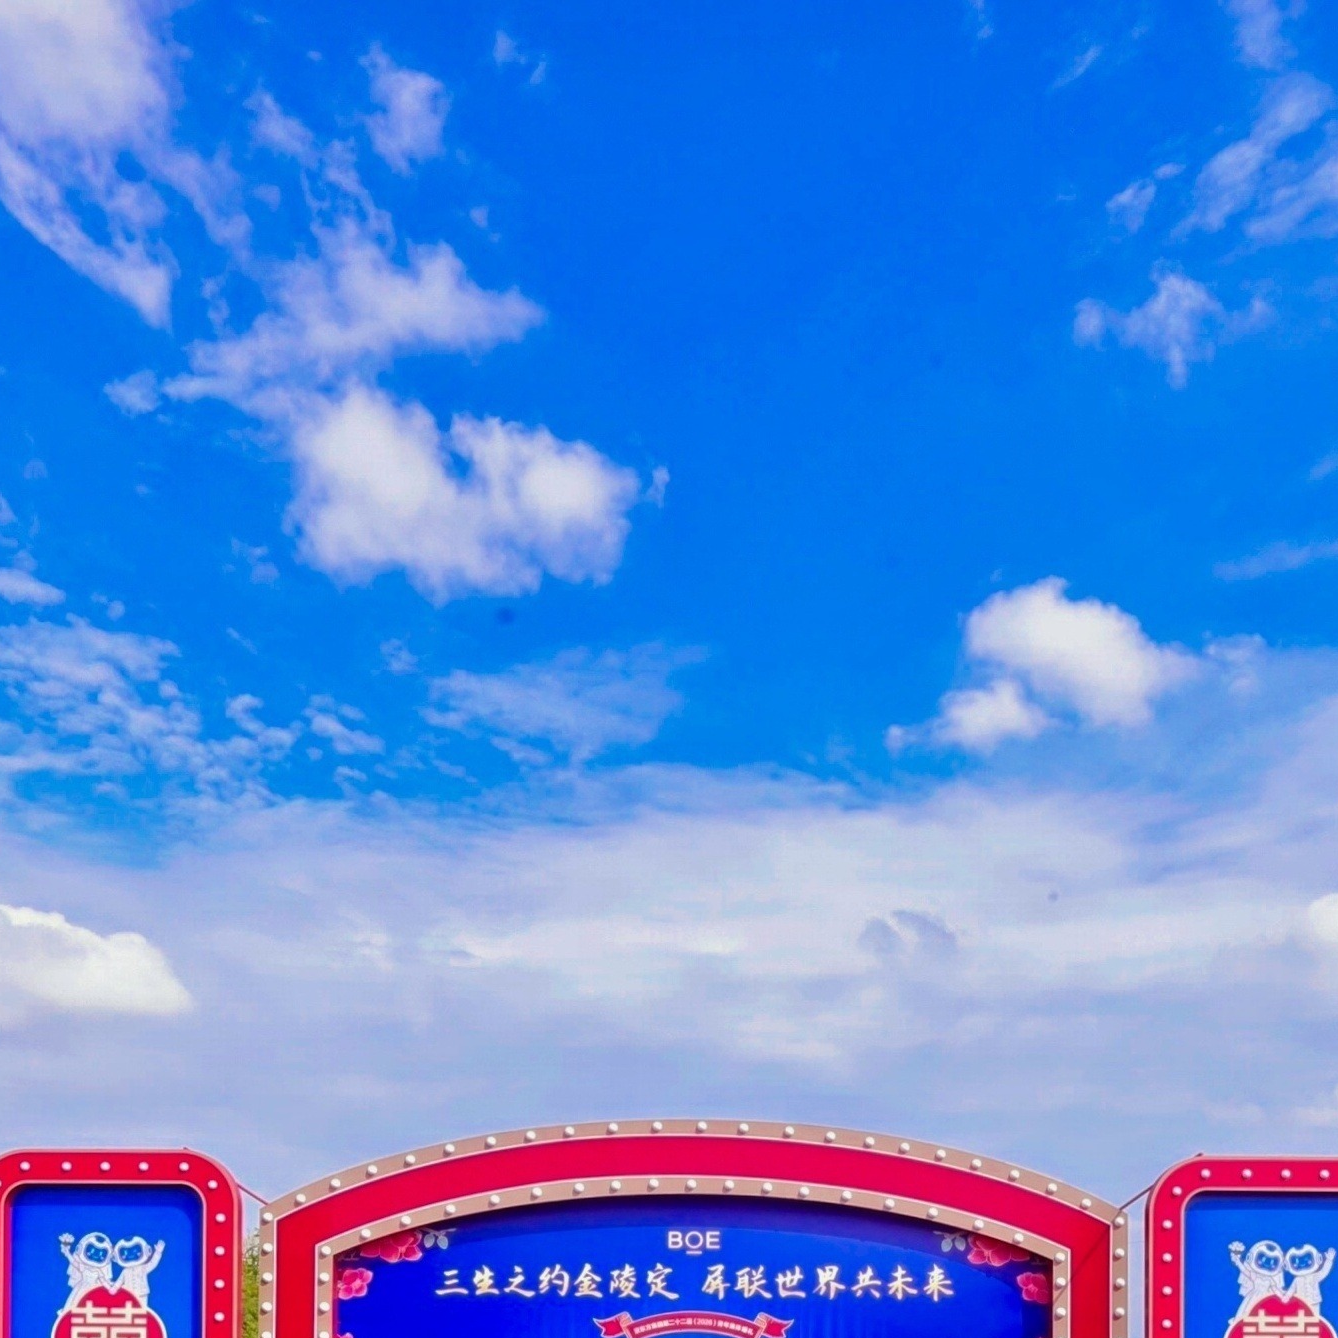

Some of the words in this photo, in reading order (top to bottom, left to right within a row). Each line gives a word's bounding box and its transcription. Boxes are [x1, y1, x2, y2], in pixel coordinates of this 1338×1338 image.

[668, 1231, 721, 1254] BOE
[435, 1262, 681, 1301] 三生之约金陵定
[701, 1263, 956, 1301] 屏联世界共未来
